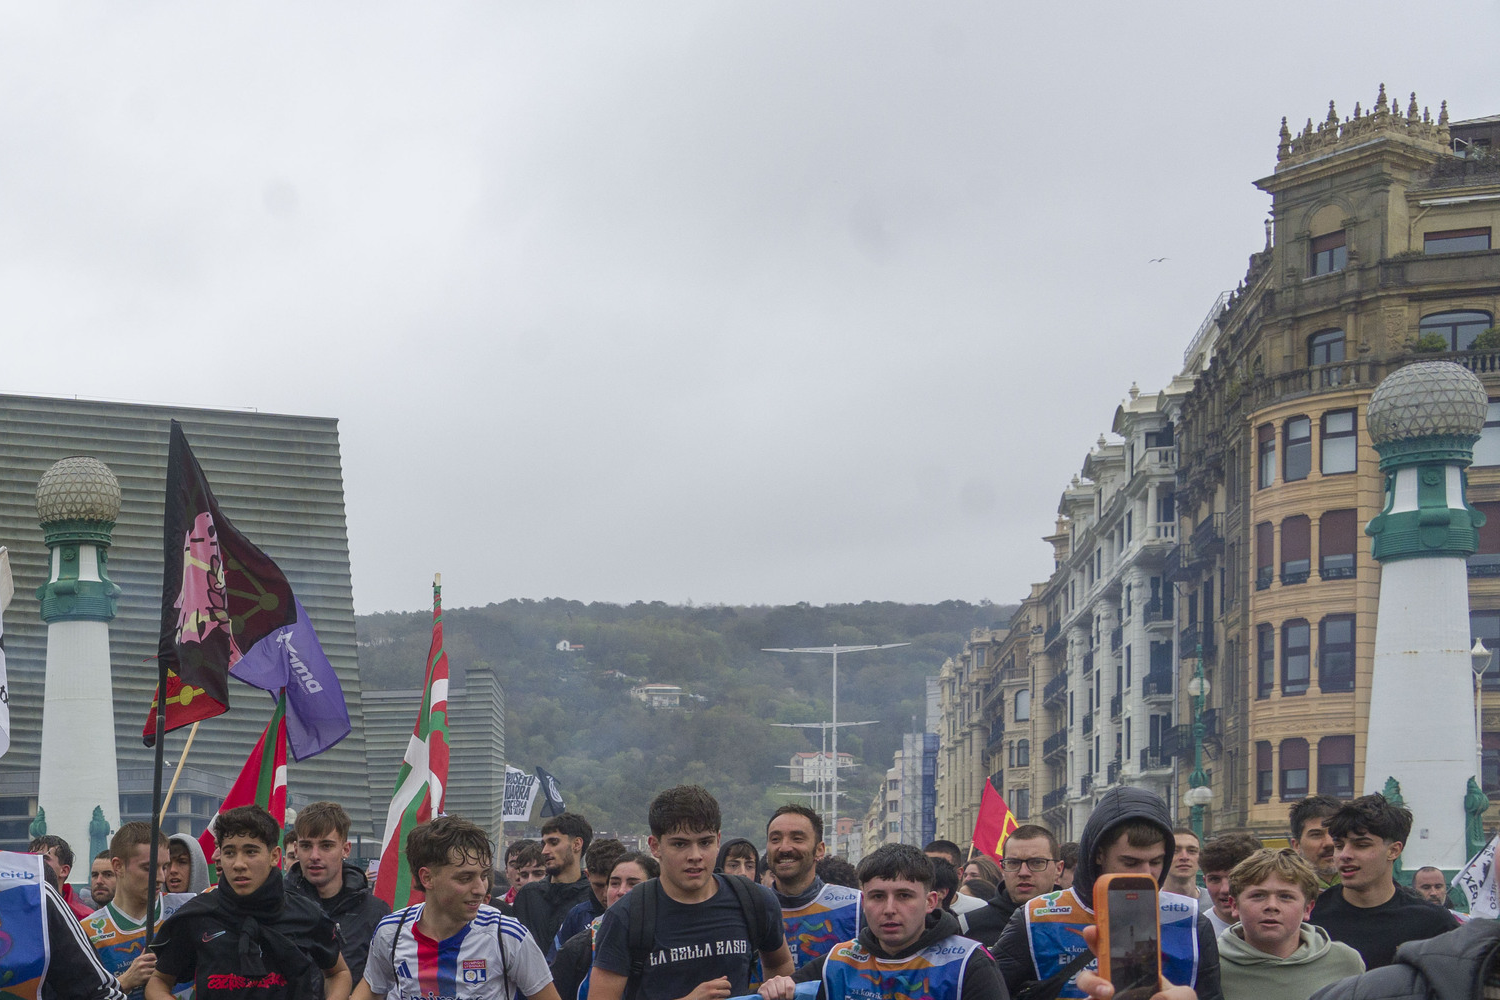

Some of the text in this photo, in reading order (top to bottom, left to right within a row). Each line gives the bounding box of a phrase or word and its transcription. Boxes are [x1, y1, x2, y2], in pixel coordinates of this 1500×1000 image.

[0, 870, 34, 879] eitb
[1160, 904, 1189, 912] eitb
[942, 945, 965, 955] eitb
[650, 950, 667, 966] LA
